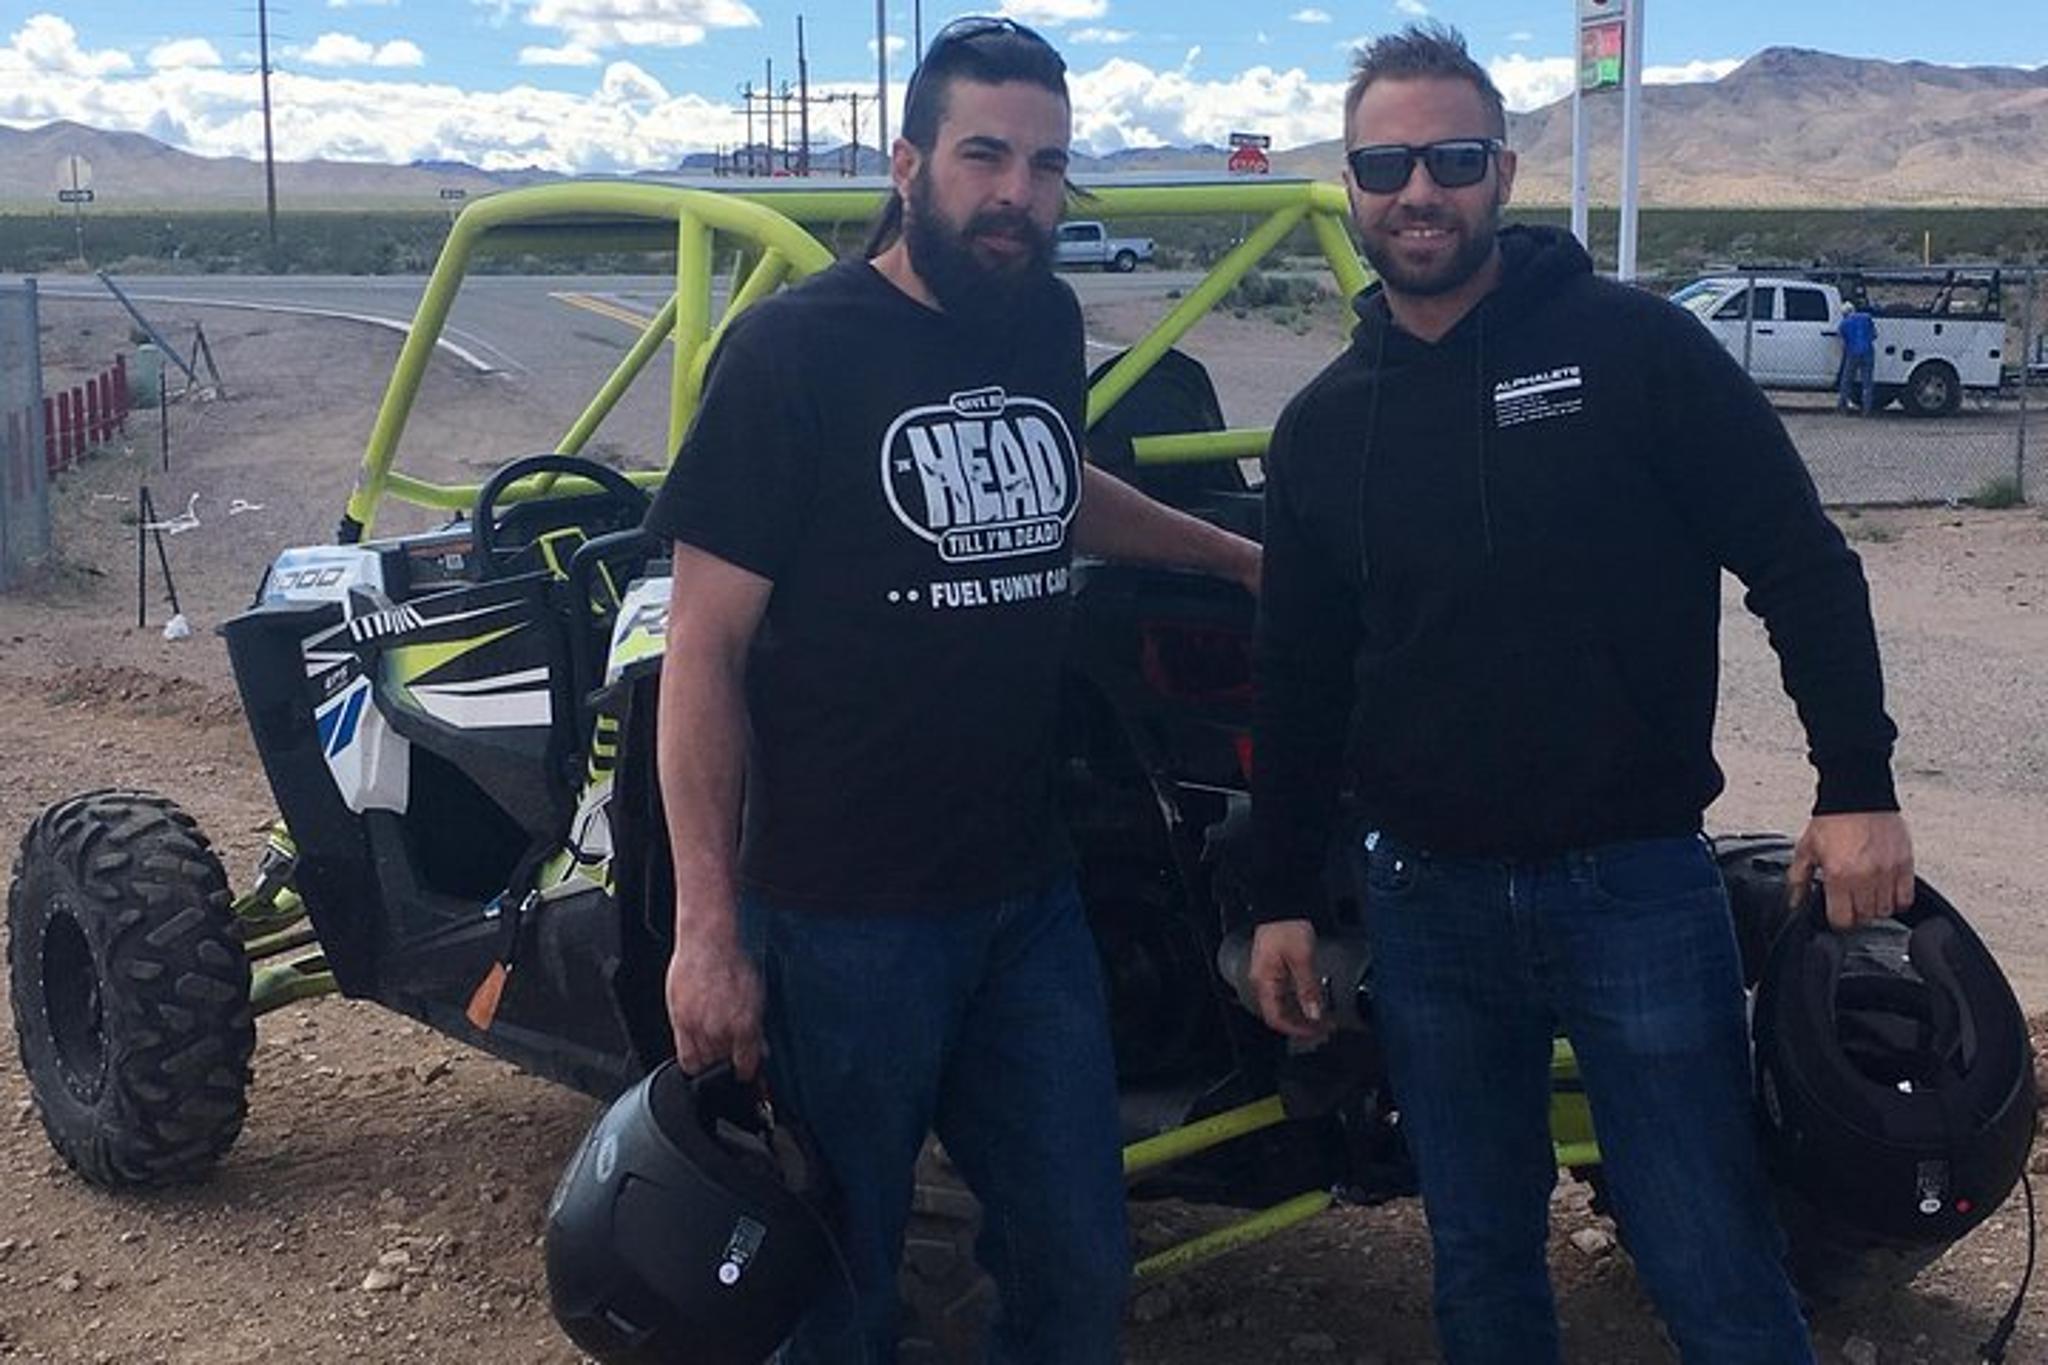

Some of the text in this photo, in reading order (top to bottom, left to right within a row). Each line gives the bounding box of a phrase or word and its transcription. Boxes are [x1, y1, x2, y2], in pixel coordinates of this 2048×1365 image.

[907, 416, 1068, 528] HEAD
[948, 533, 983, 555] TILL
[930, 580, 988, 608] FUEL
[990, 571, 1043, 603] FUNNY
